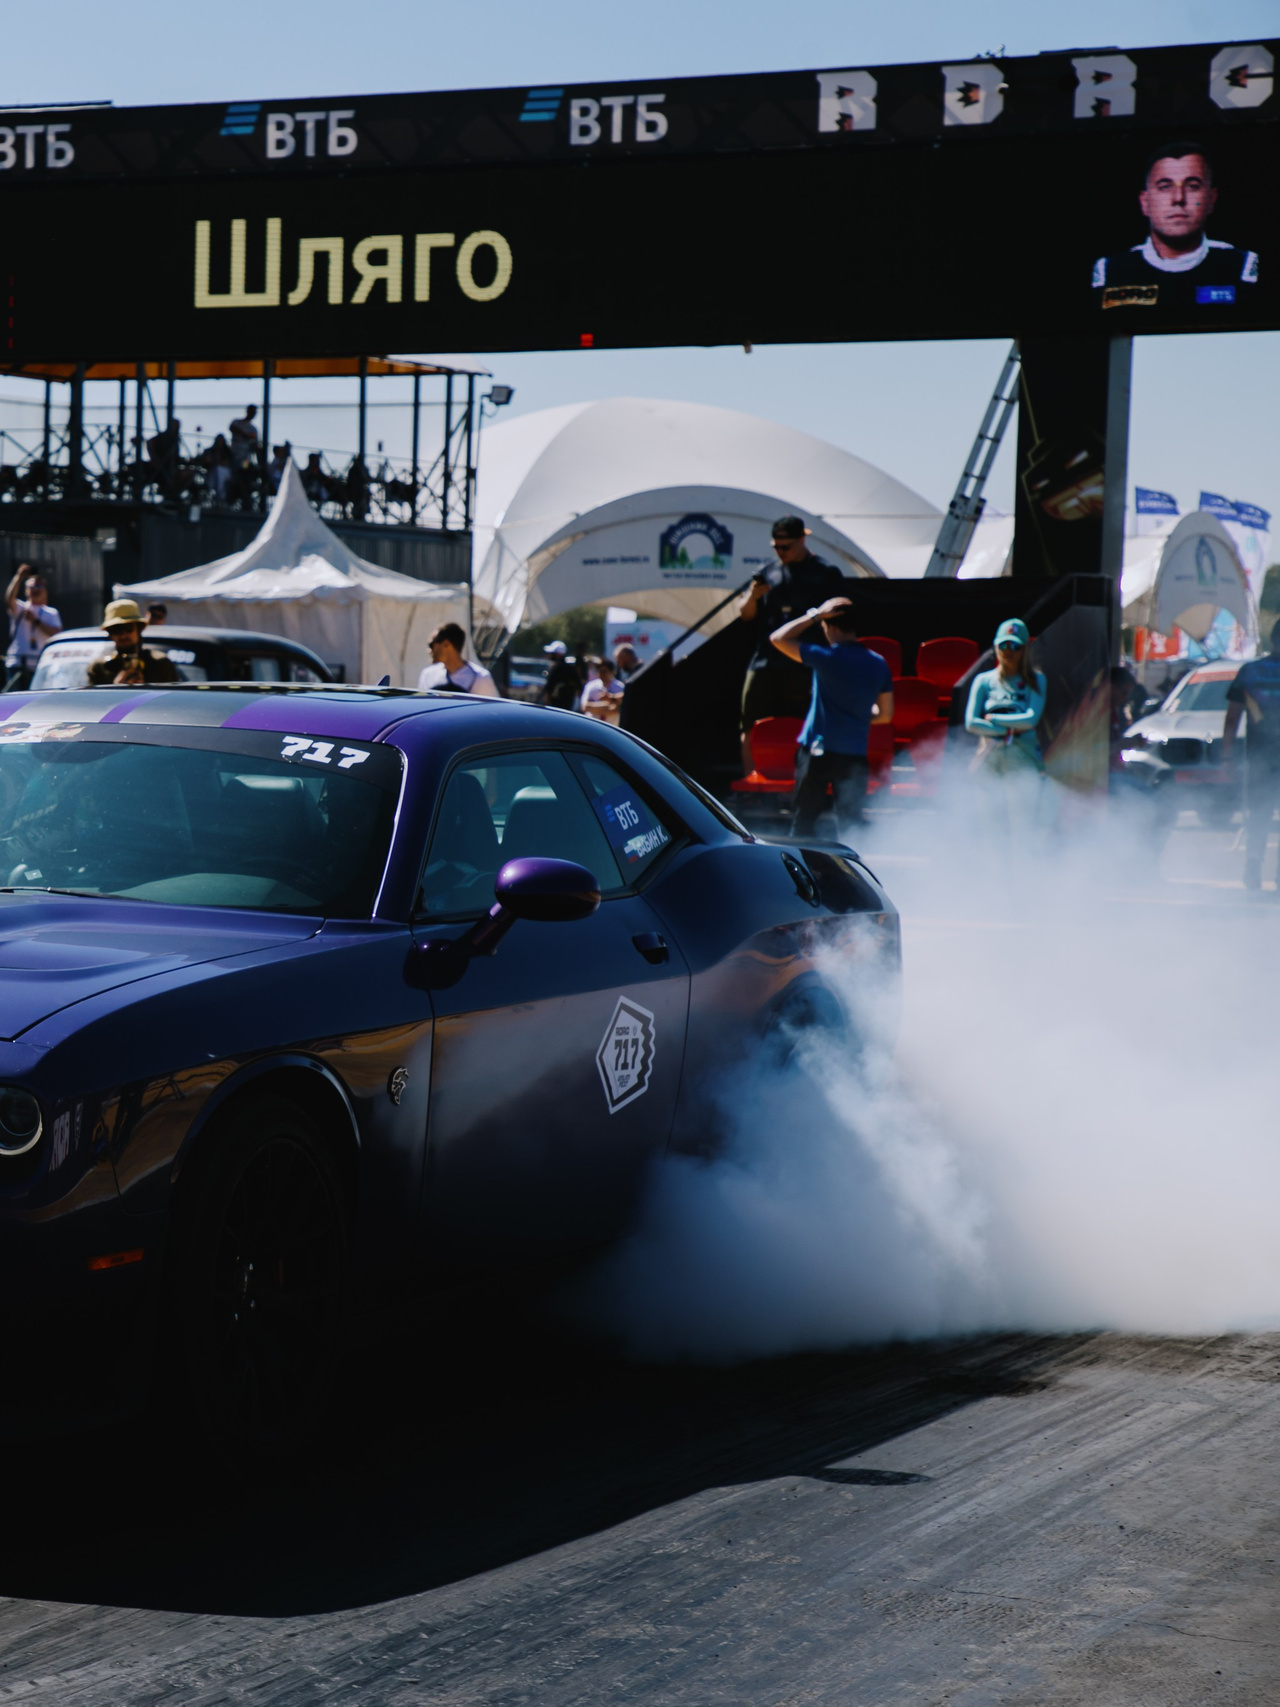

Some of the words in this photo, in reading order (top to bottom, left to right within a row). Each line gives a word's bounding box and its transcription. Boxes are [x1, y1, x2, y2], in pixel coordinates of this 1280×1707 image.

[266, 109, 358, 159] ВТБ
[569, 93, 669, 146] ВТБ
[194, 217, 513, 309] Шляго
[281, 735, 371, 769] 717
[614, 801, 639, 830] ВТБ
[614, 1037, 640, 1071] 717
